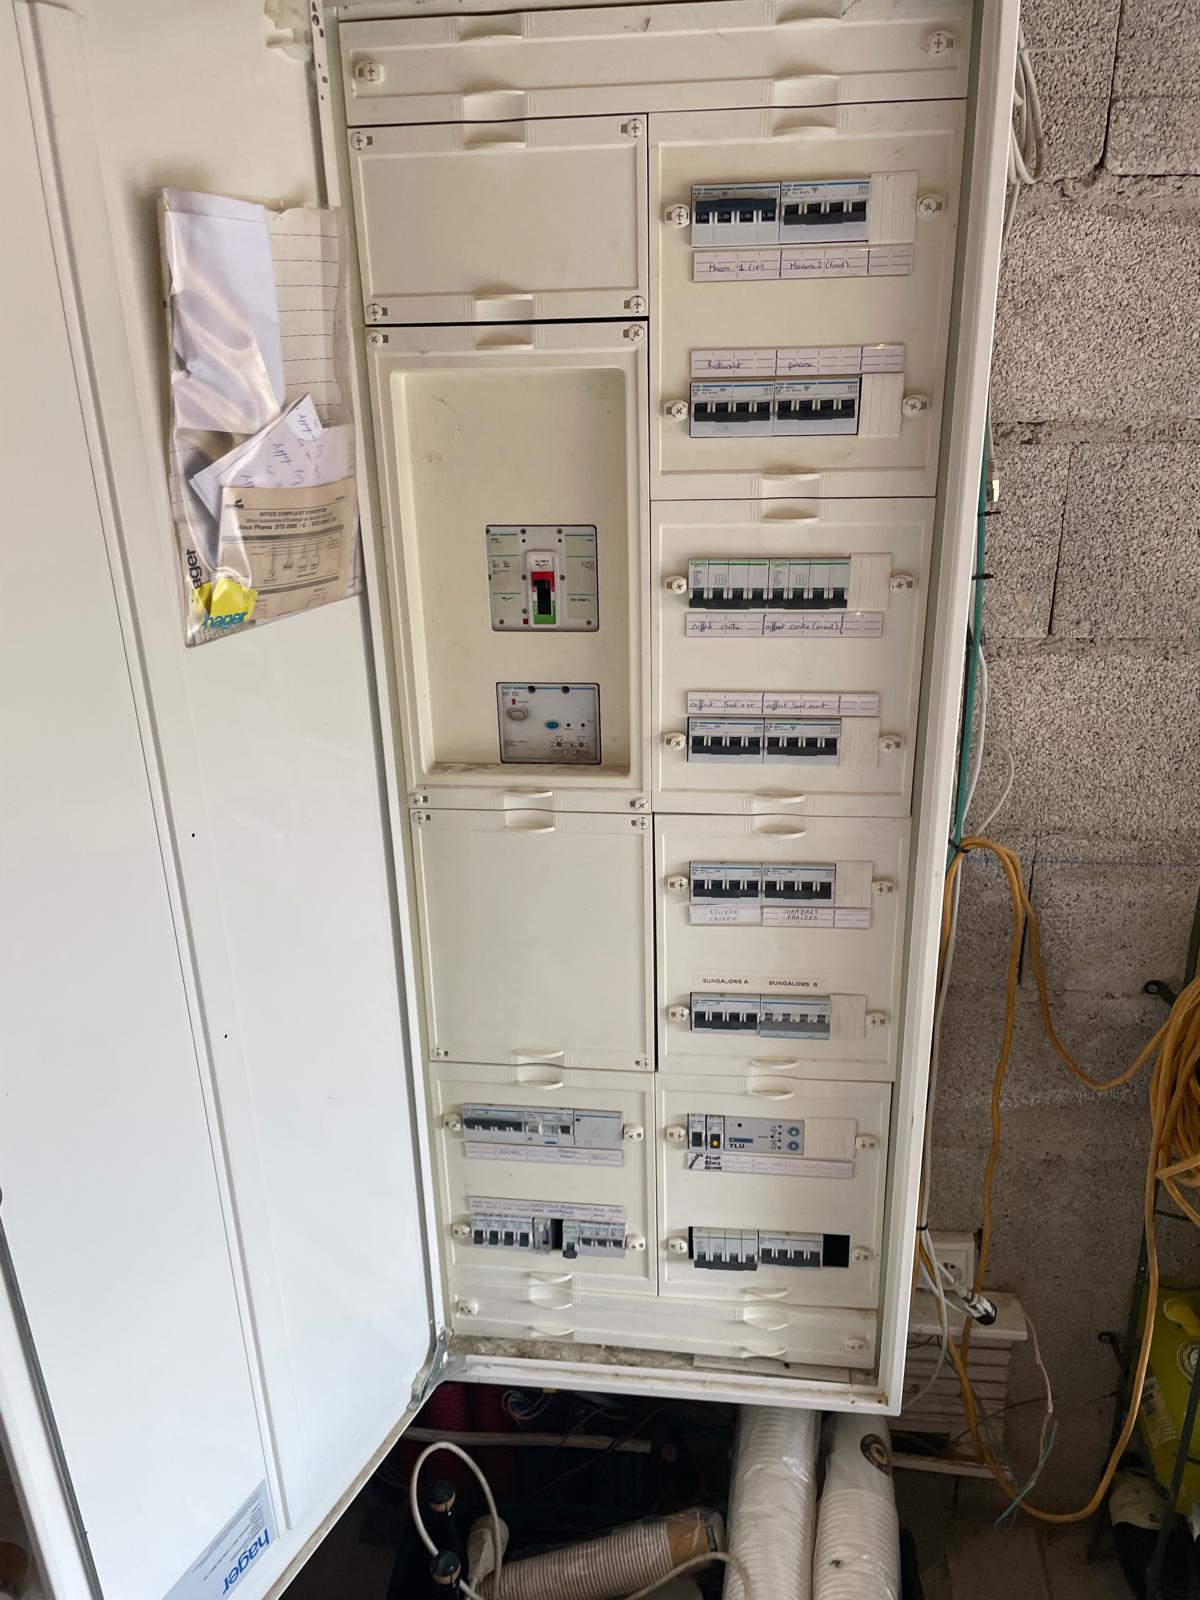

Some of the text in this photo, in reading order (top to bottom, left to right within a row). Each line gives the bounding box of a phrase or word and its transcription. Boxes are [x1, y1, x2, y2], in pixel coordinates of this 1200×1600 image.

[738, 263, 745, 272] 1
[817, 260, 823, 269] 2
[202, 611, 248, 630] hager
[768, 980, 810, 988] BUNGALOWS
[222, 1528, 270, 1595] hager
